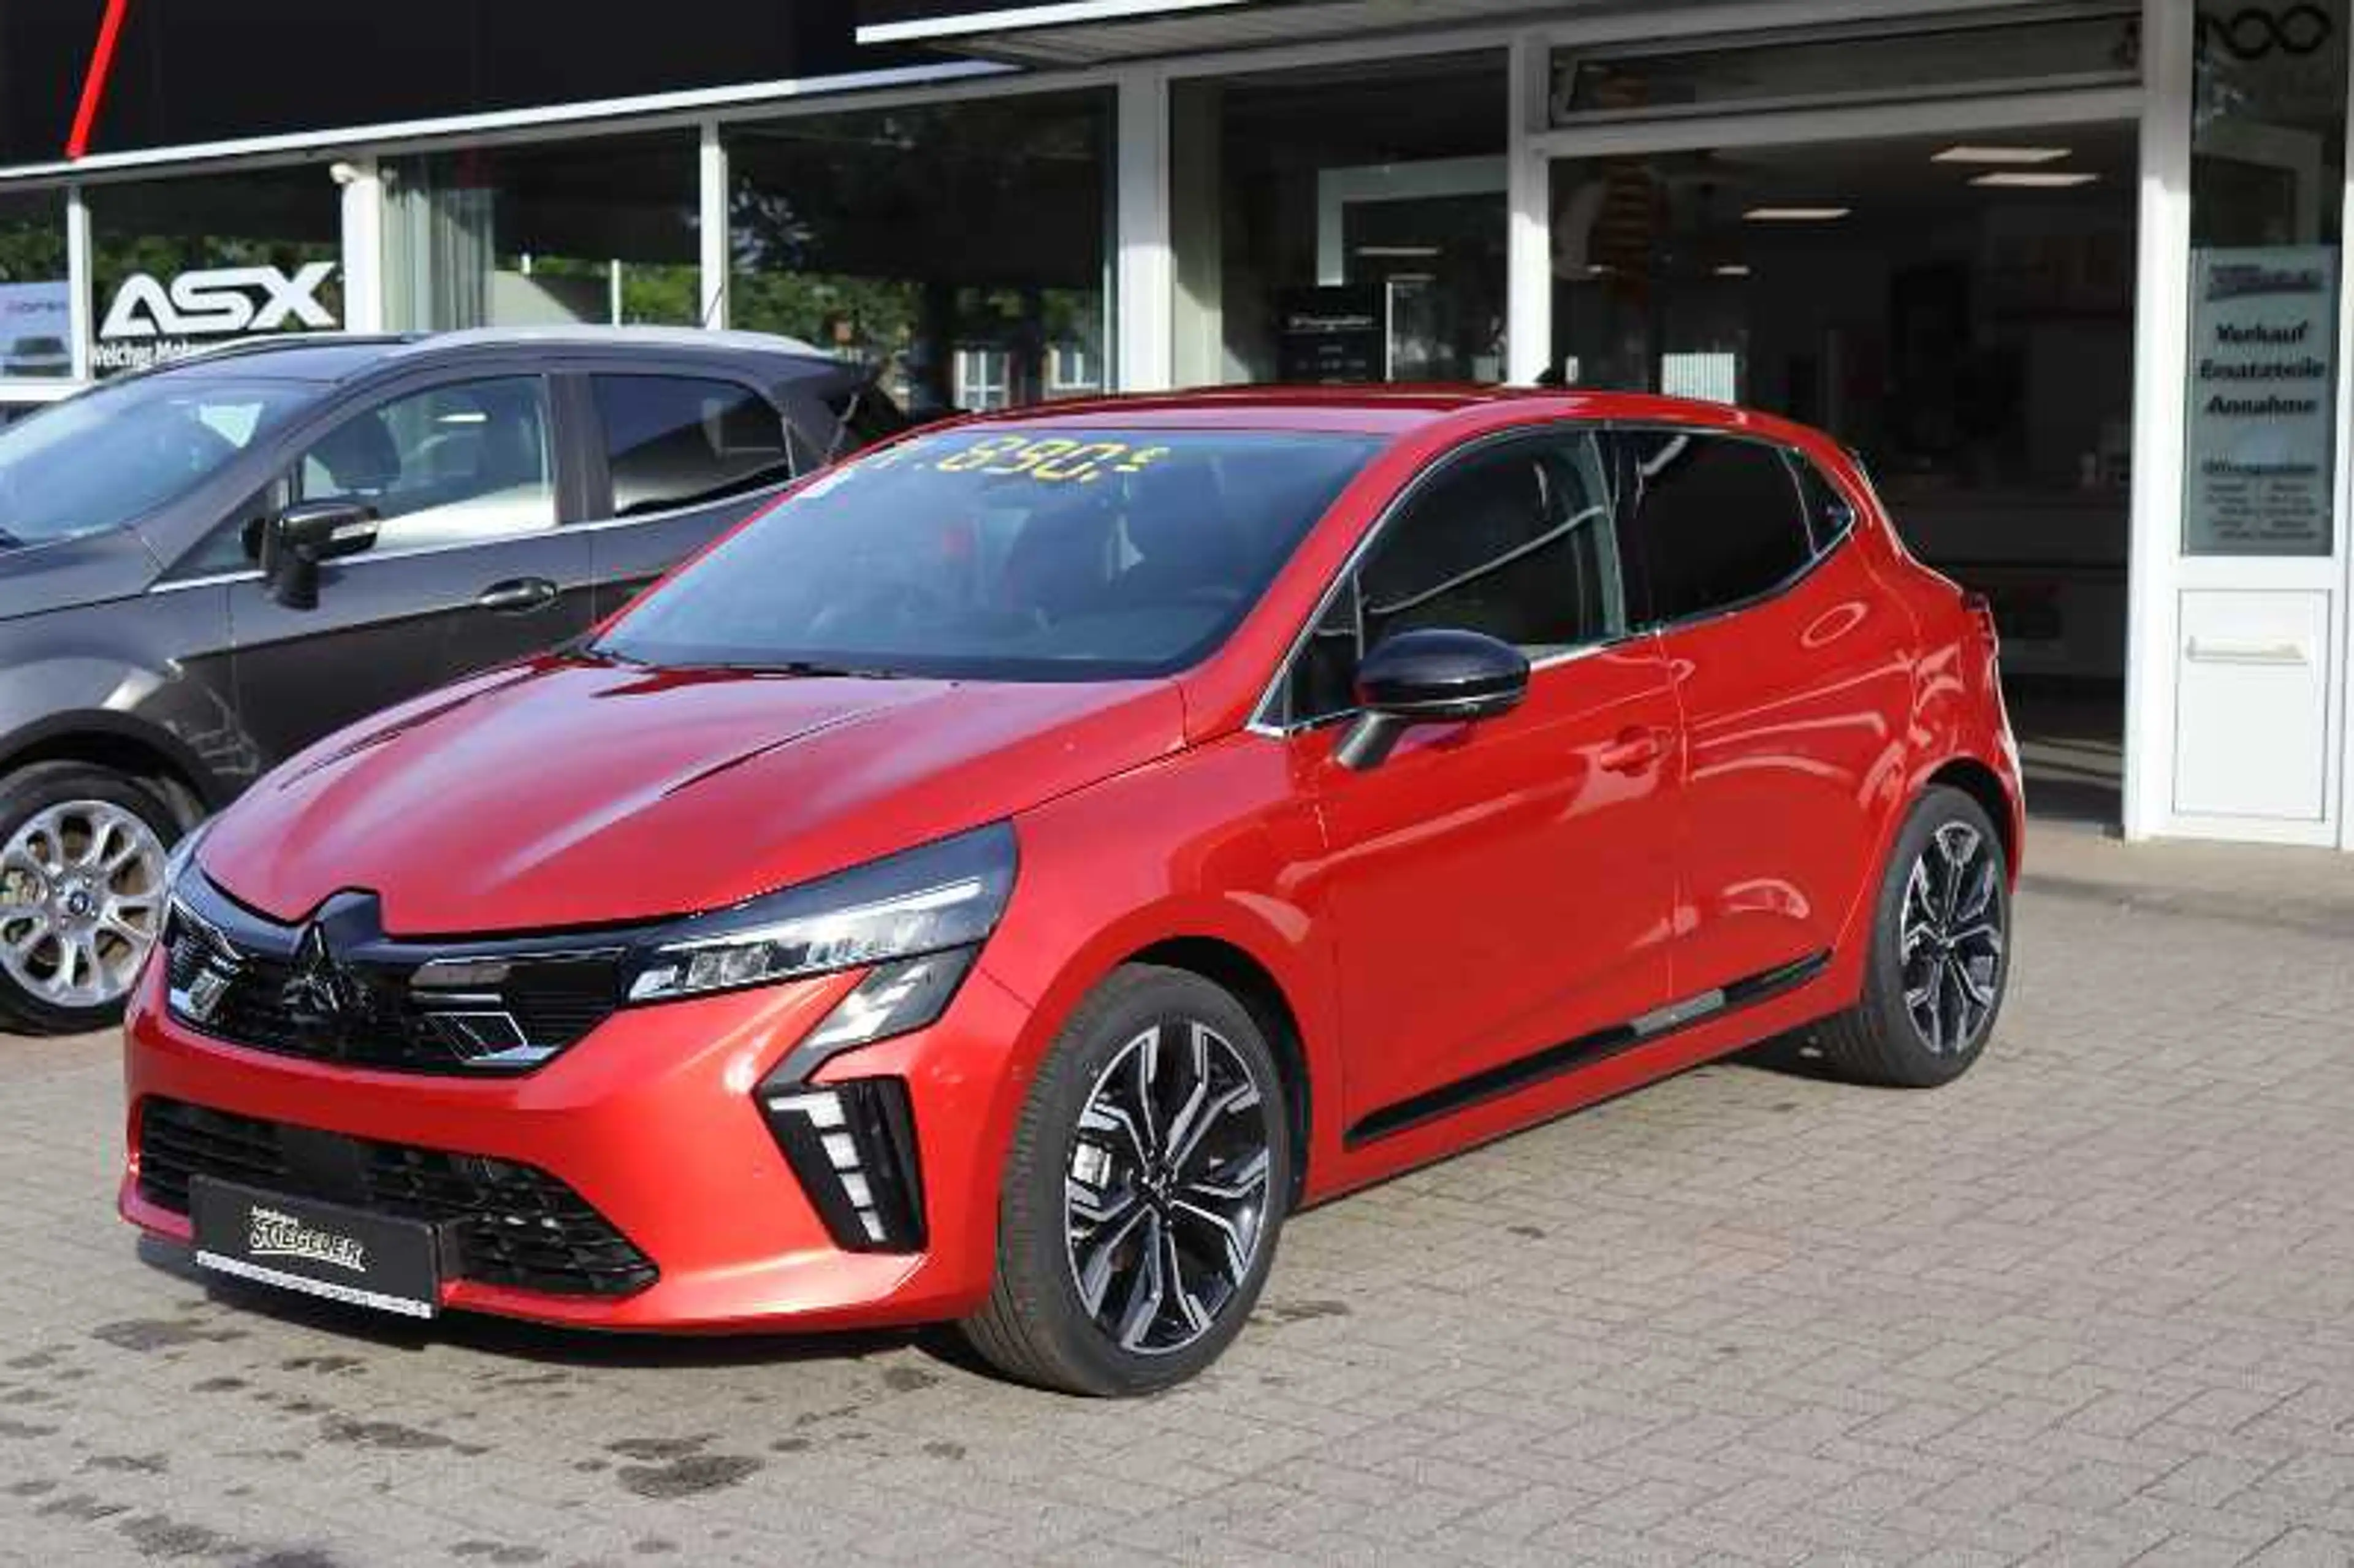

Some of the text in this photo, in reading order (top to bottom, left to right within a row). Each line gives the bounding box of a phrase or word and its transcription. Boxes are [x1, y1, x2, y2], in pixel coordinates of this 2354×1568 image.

[101, 262, 337, 338] ASX
[2215, 320, 2309, 344] Verkauf
[2206, 394, 2318, 416] Annahme
